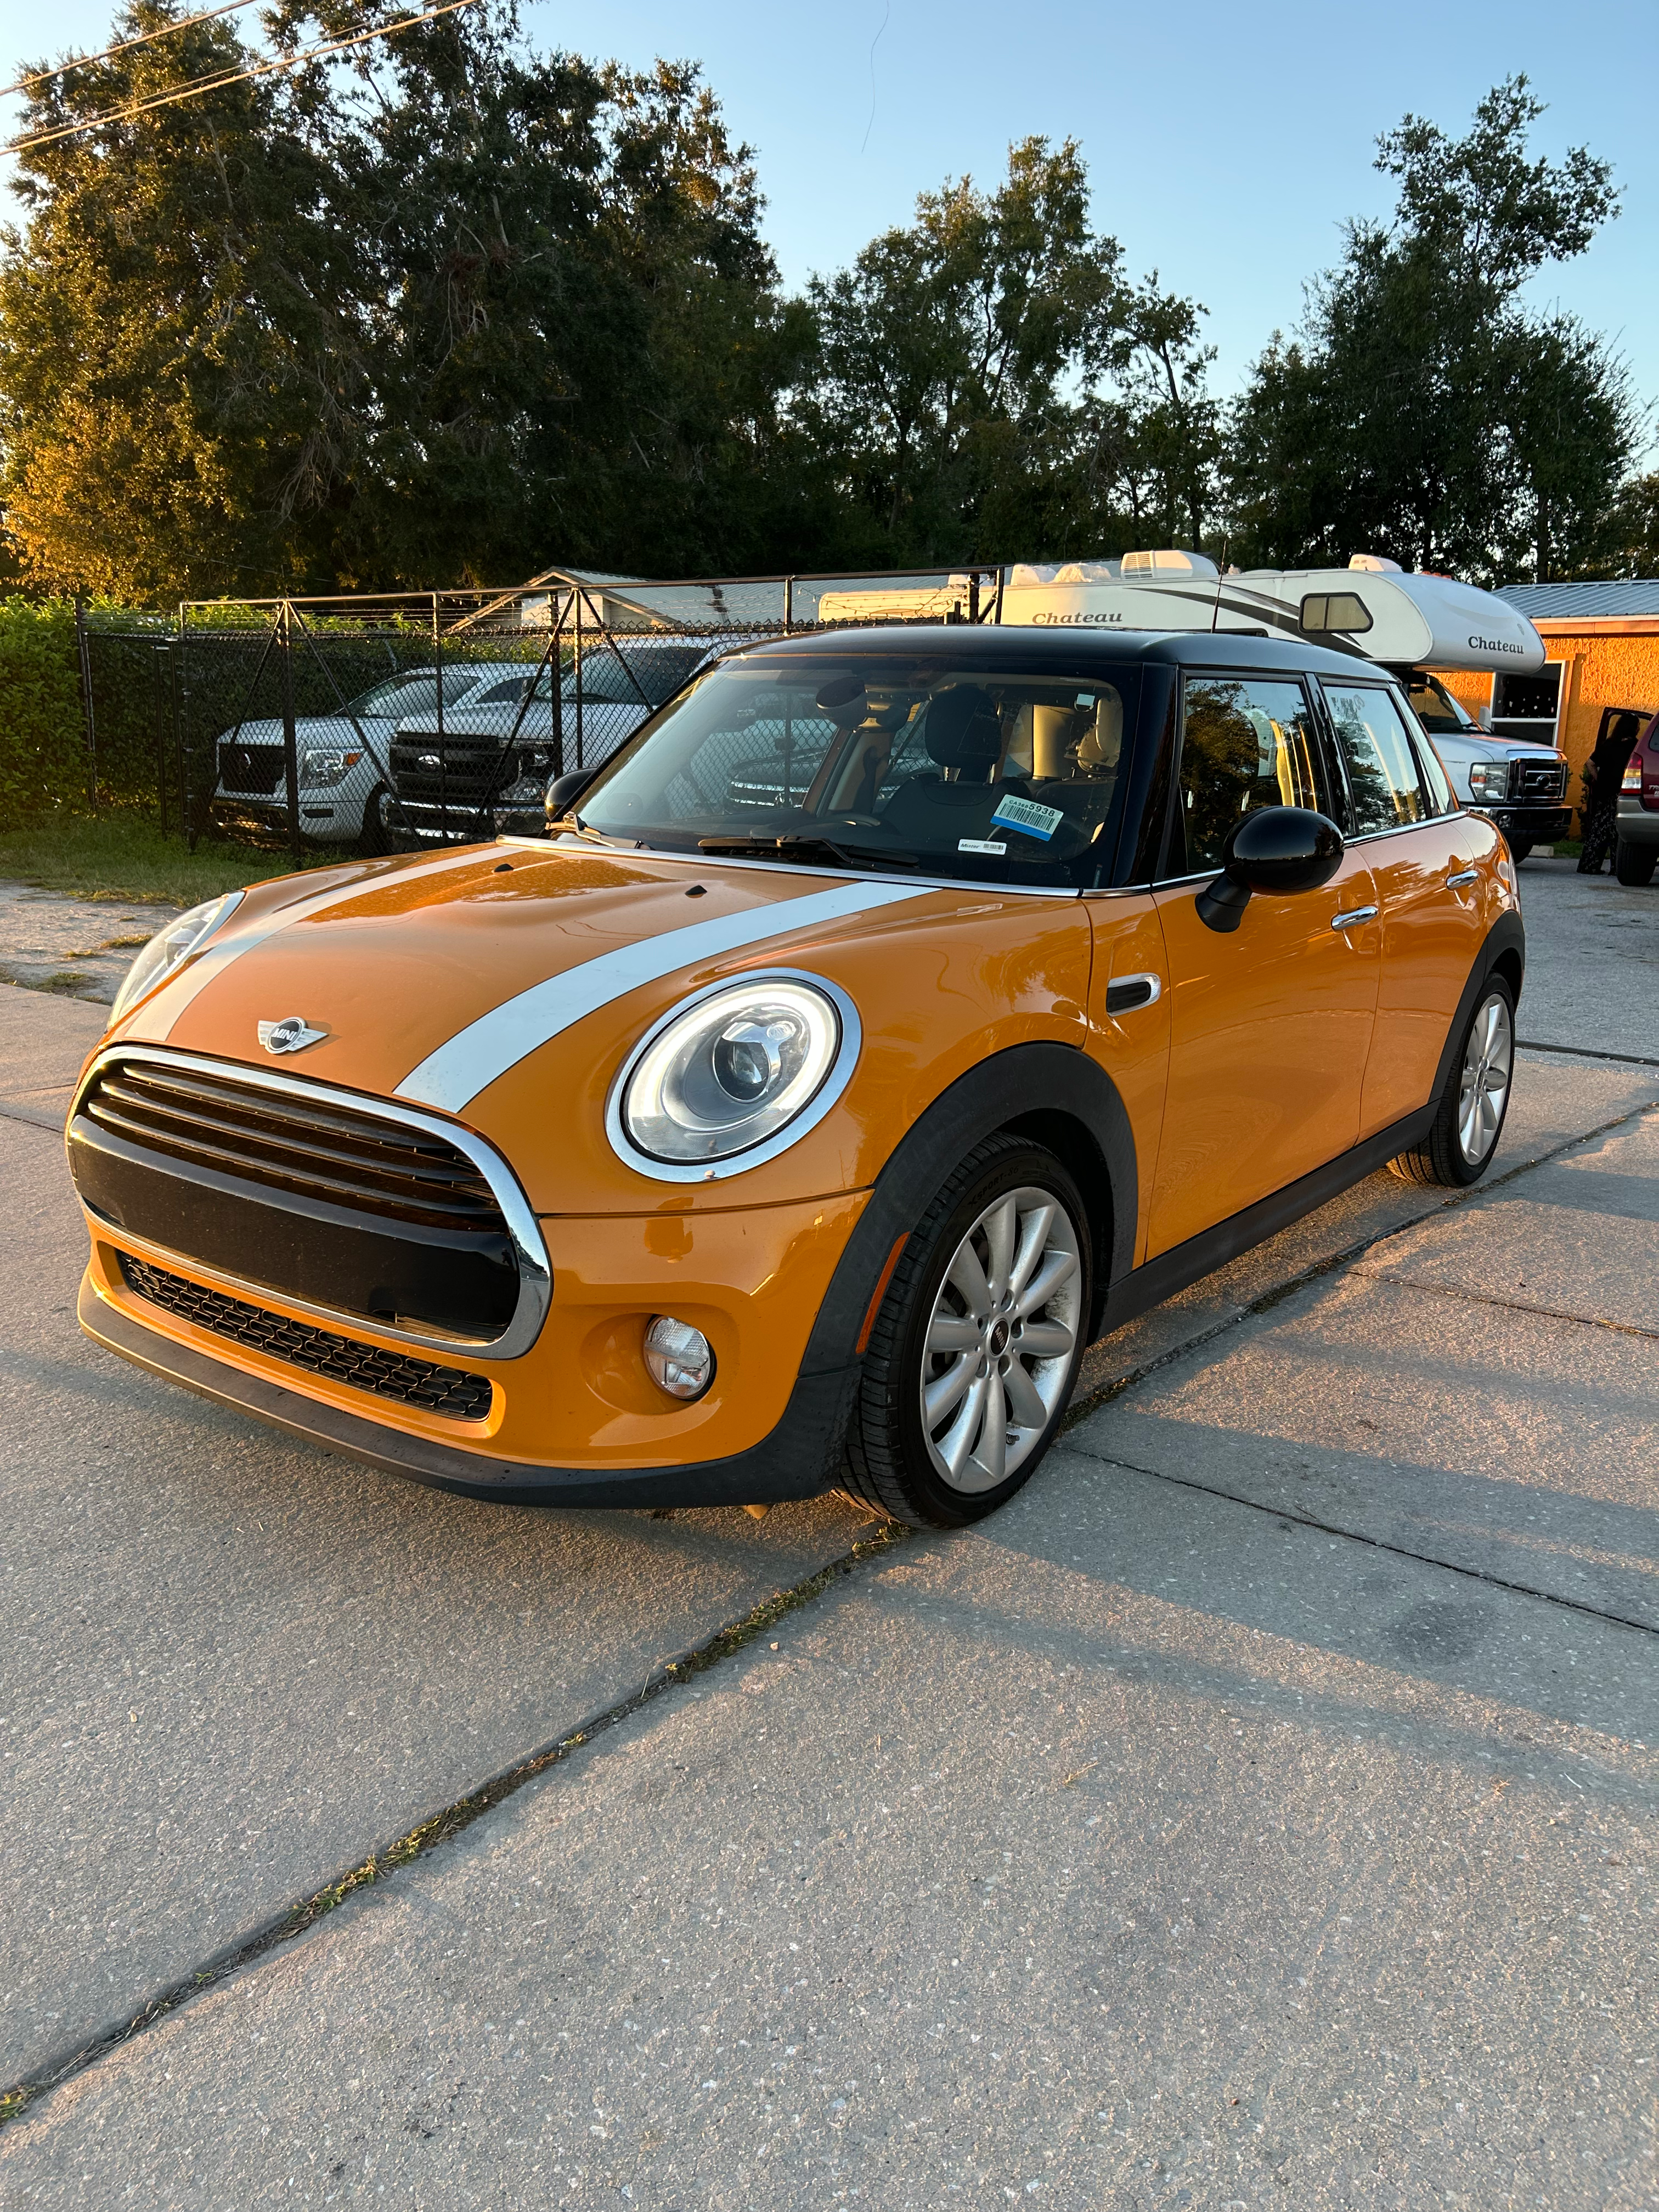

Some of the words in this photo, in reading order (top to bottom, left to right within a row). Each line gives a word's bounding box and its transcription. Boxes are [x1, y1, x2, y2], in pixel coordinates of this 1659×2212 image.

[1032, 612, 1122, 624] Chateau
[1468, 636, 1524, 654] Chateau
[272, 1028, 298, 1041] MINI
[995, 1325, 1006, 1350] MINI
